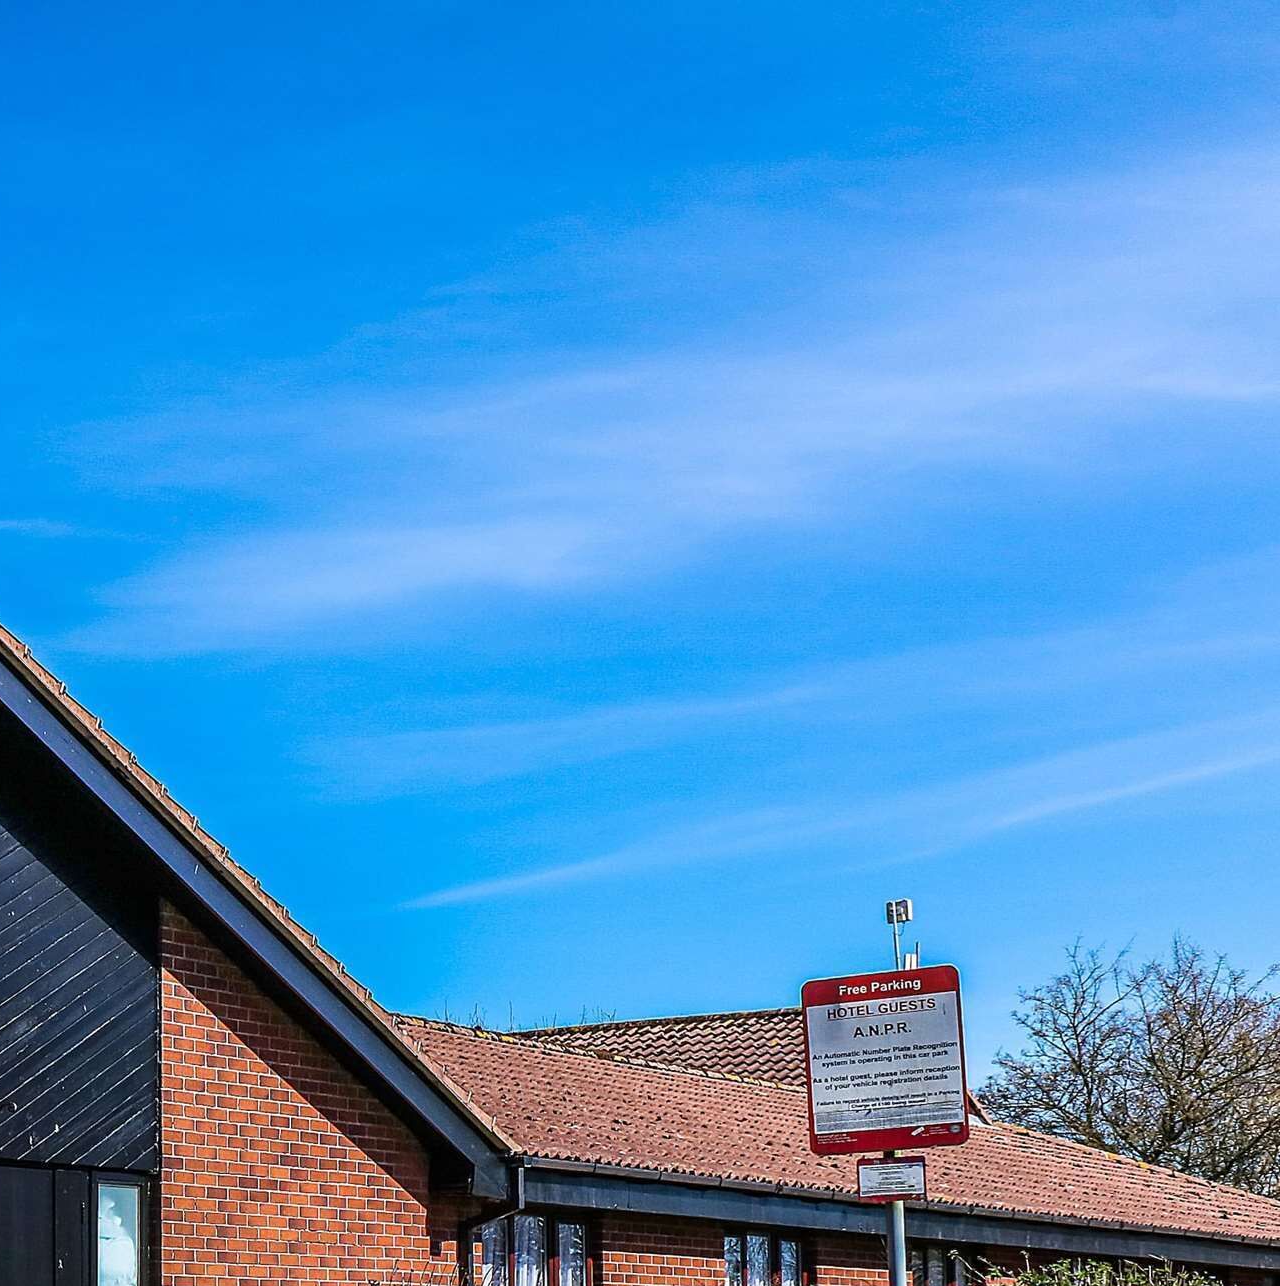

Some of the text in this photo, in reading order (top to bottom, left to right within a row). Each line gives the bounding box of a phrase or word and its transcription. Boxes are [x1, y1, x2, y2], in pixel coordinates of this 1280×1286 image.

[838, 979, 921, 996] Free Parking
[827, 998, 936, 1019] HOTEL GUESTS
[853, 1022, 912, 1038] A.N.P.R.
[824, 1049, 860, 1059] Automatic
[862, 1047, 891, 1056] Number
[913, 1040, 957, 1051] Recognition
[822, 1060, 848, 1069] system
[857, 1055, 892, 1065] operating
[894, 1053, 901, 1061] in
[903, 1052, 916, 1060] this
[874, 1070, 898, 1079] please
[899, 1068, 923, 1076] inform
[925, 1064, 960, 1074] reception
[834, 1083, 851, 1091] your
[852, 1079, 878, 1088] vehicle
[880, 1075, 921, 1086] registration
